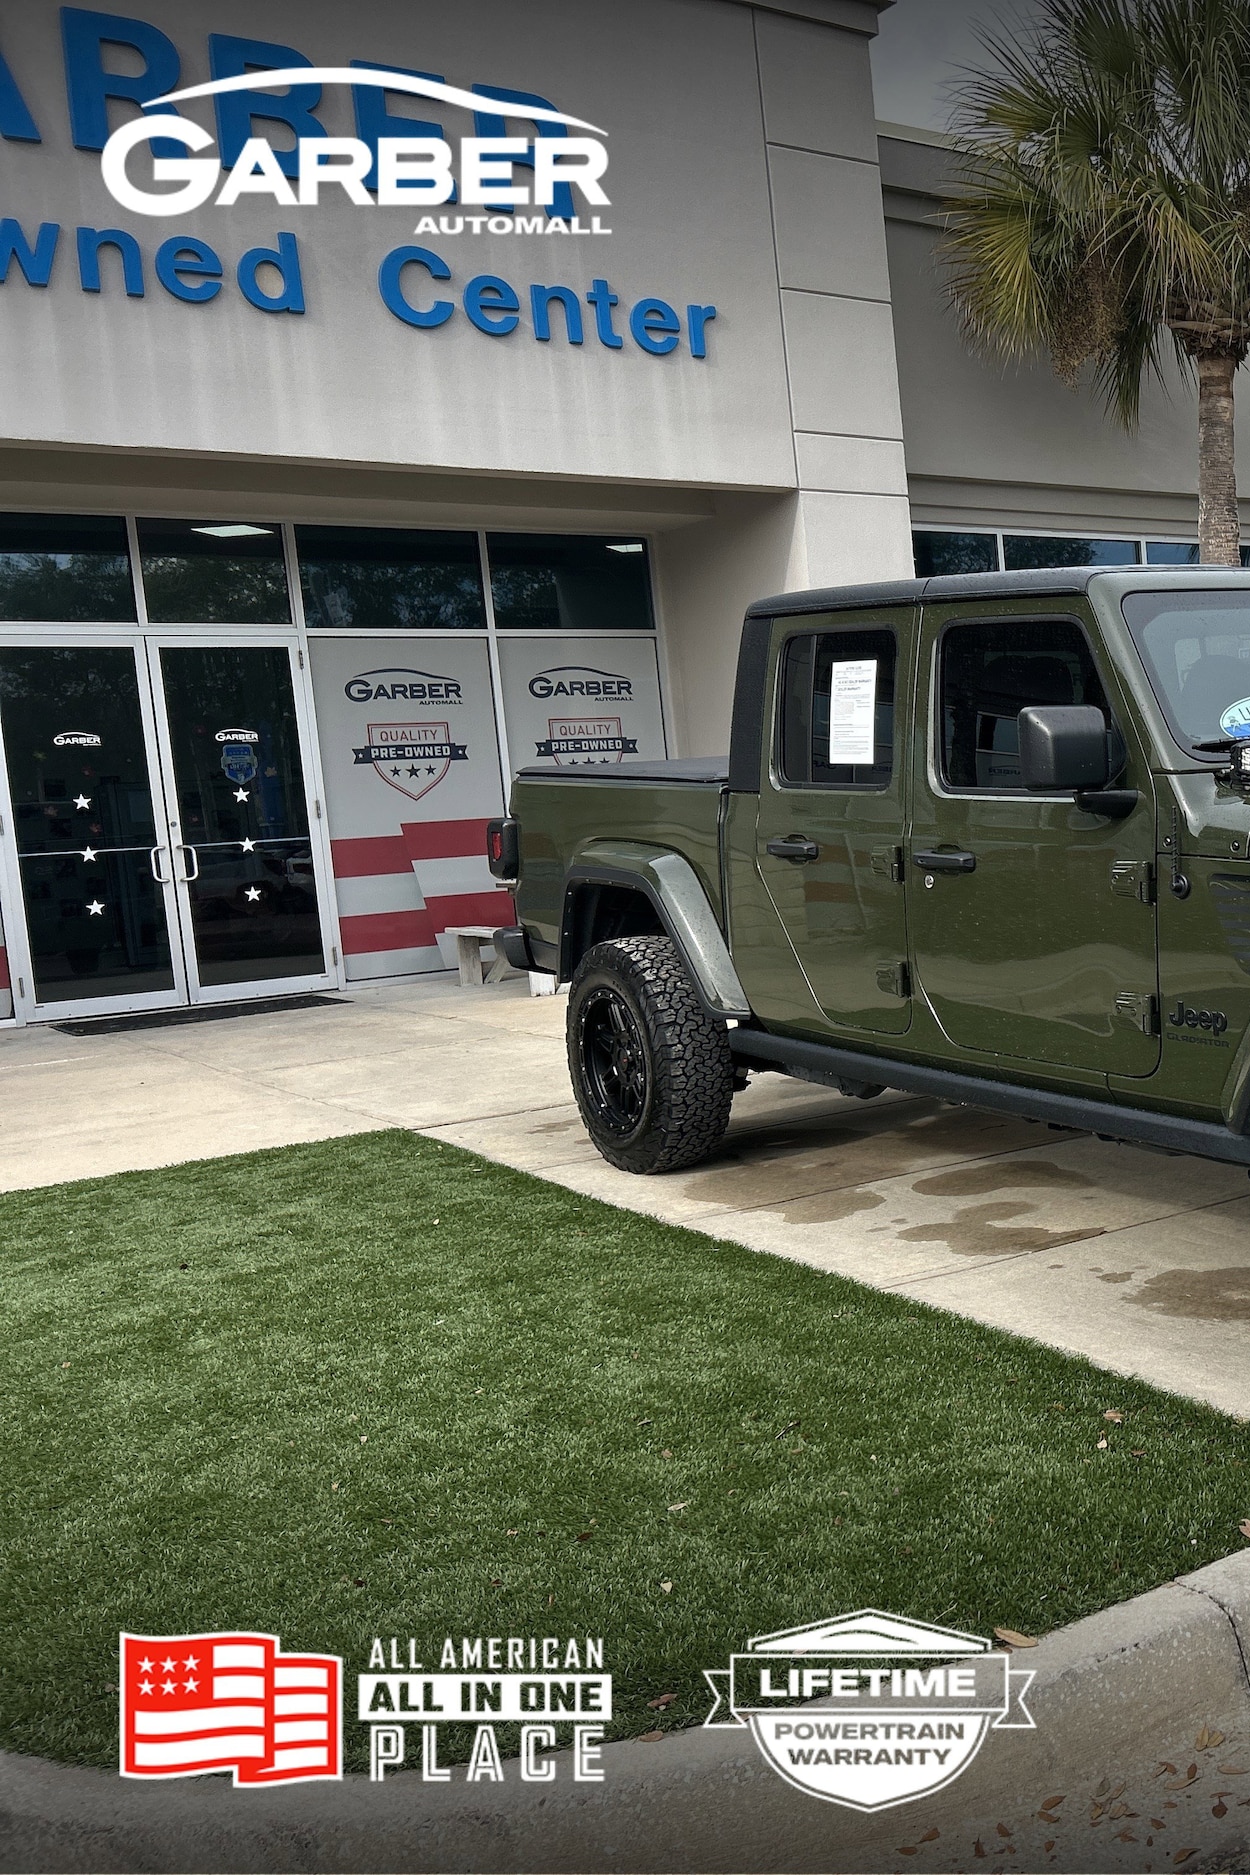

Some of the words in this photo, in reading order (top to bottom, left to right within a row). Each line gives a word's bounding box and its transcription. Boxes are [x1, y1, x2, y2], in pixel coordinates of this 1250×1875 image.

[378, 246, 716, 359] Center
[344, 679, 462, 702] GARBER
[528, 676, 633, 699] GARBER
[215, 732, 259, 742] GARBER
[380, 729, 438, 742] QUALITY
[559, 724, 611, 736] QUALITY
[53, 736, 101, 746] GARBER
[551, 739, 623, 752] PRE-OWNED
[371, 745, 451, 759] PRE-OWNED
[1169, 1000, 1228, 1037] Jeep
[1166, 1032, 1230, 1048] GLADIATOR
